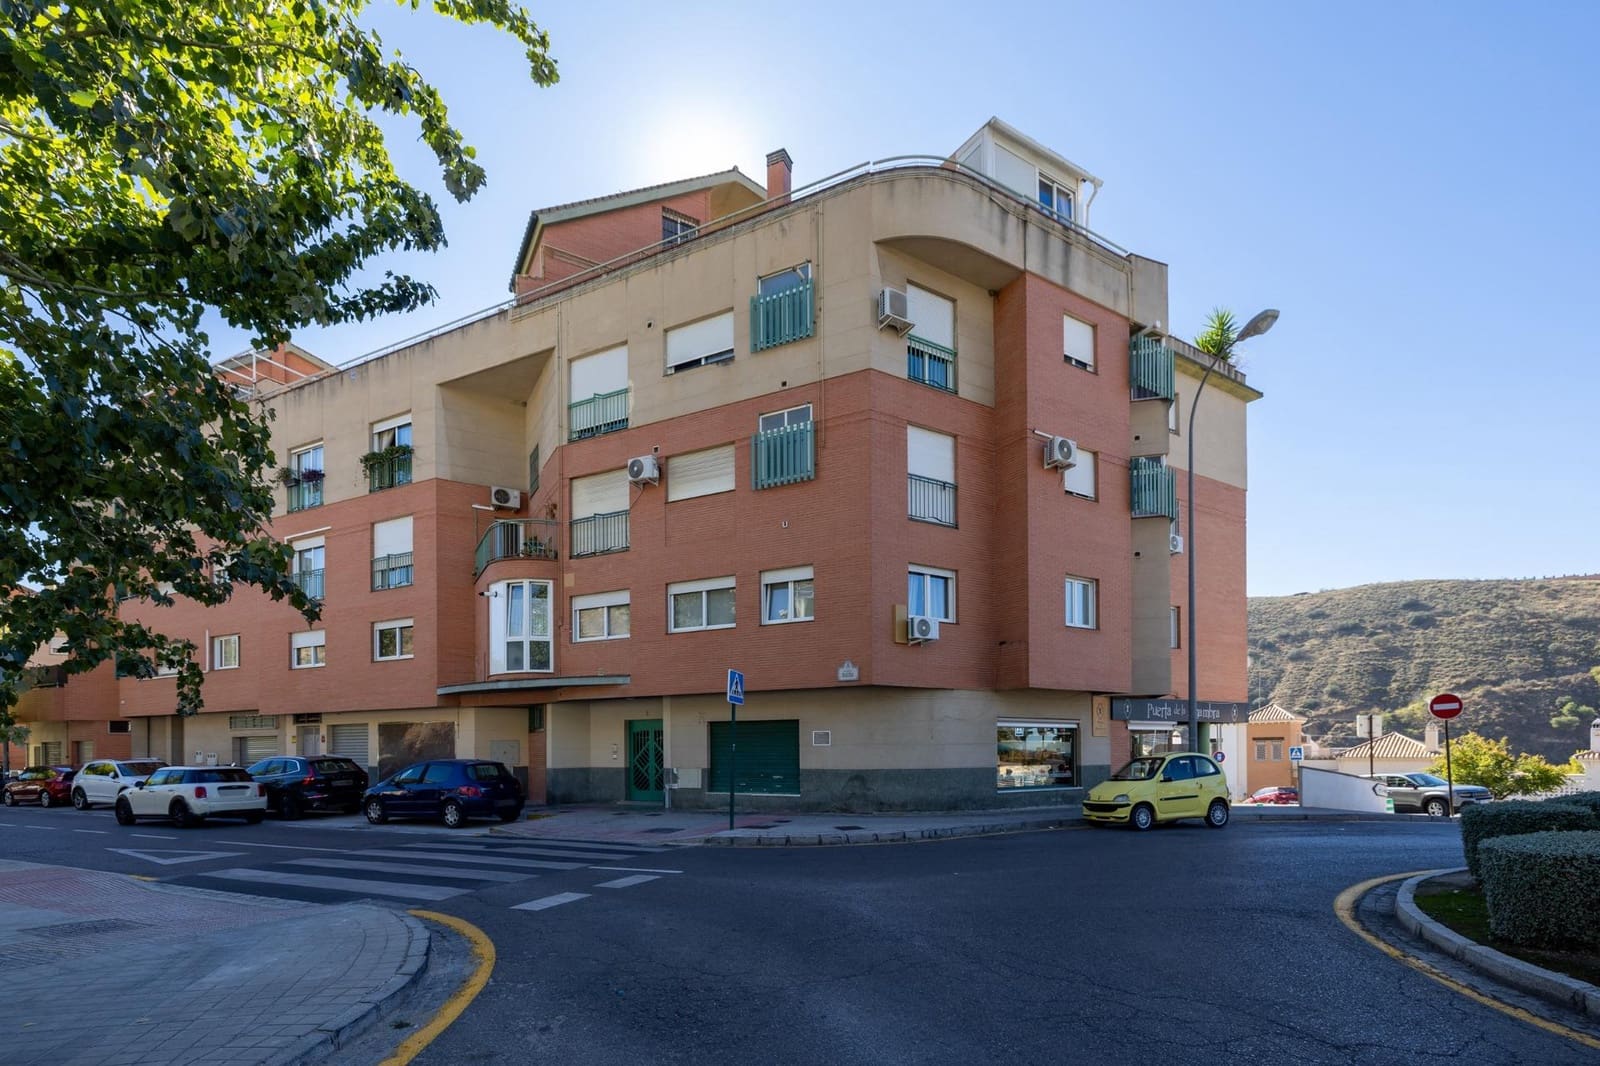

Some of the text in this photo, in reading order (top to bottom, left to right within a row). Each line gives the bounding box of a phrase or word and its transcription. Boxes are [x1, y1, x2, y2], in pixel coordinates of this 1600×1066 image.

[1147, 702, 1172, 720] Puerta
[1173, 703, 1180, 715] de
[1195, 703, 1221, 720] ambra
